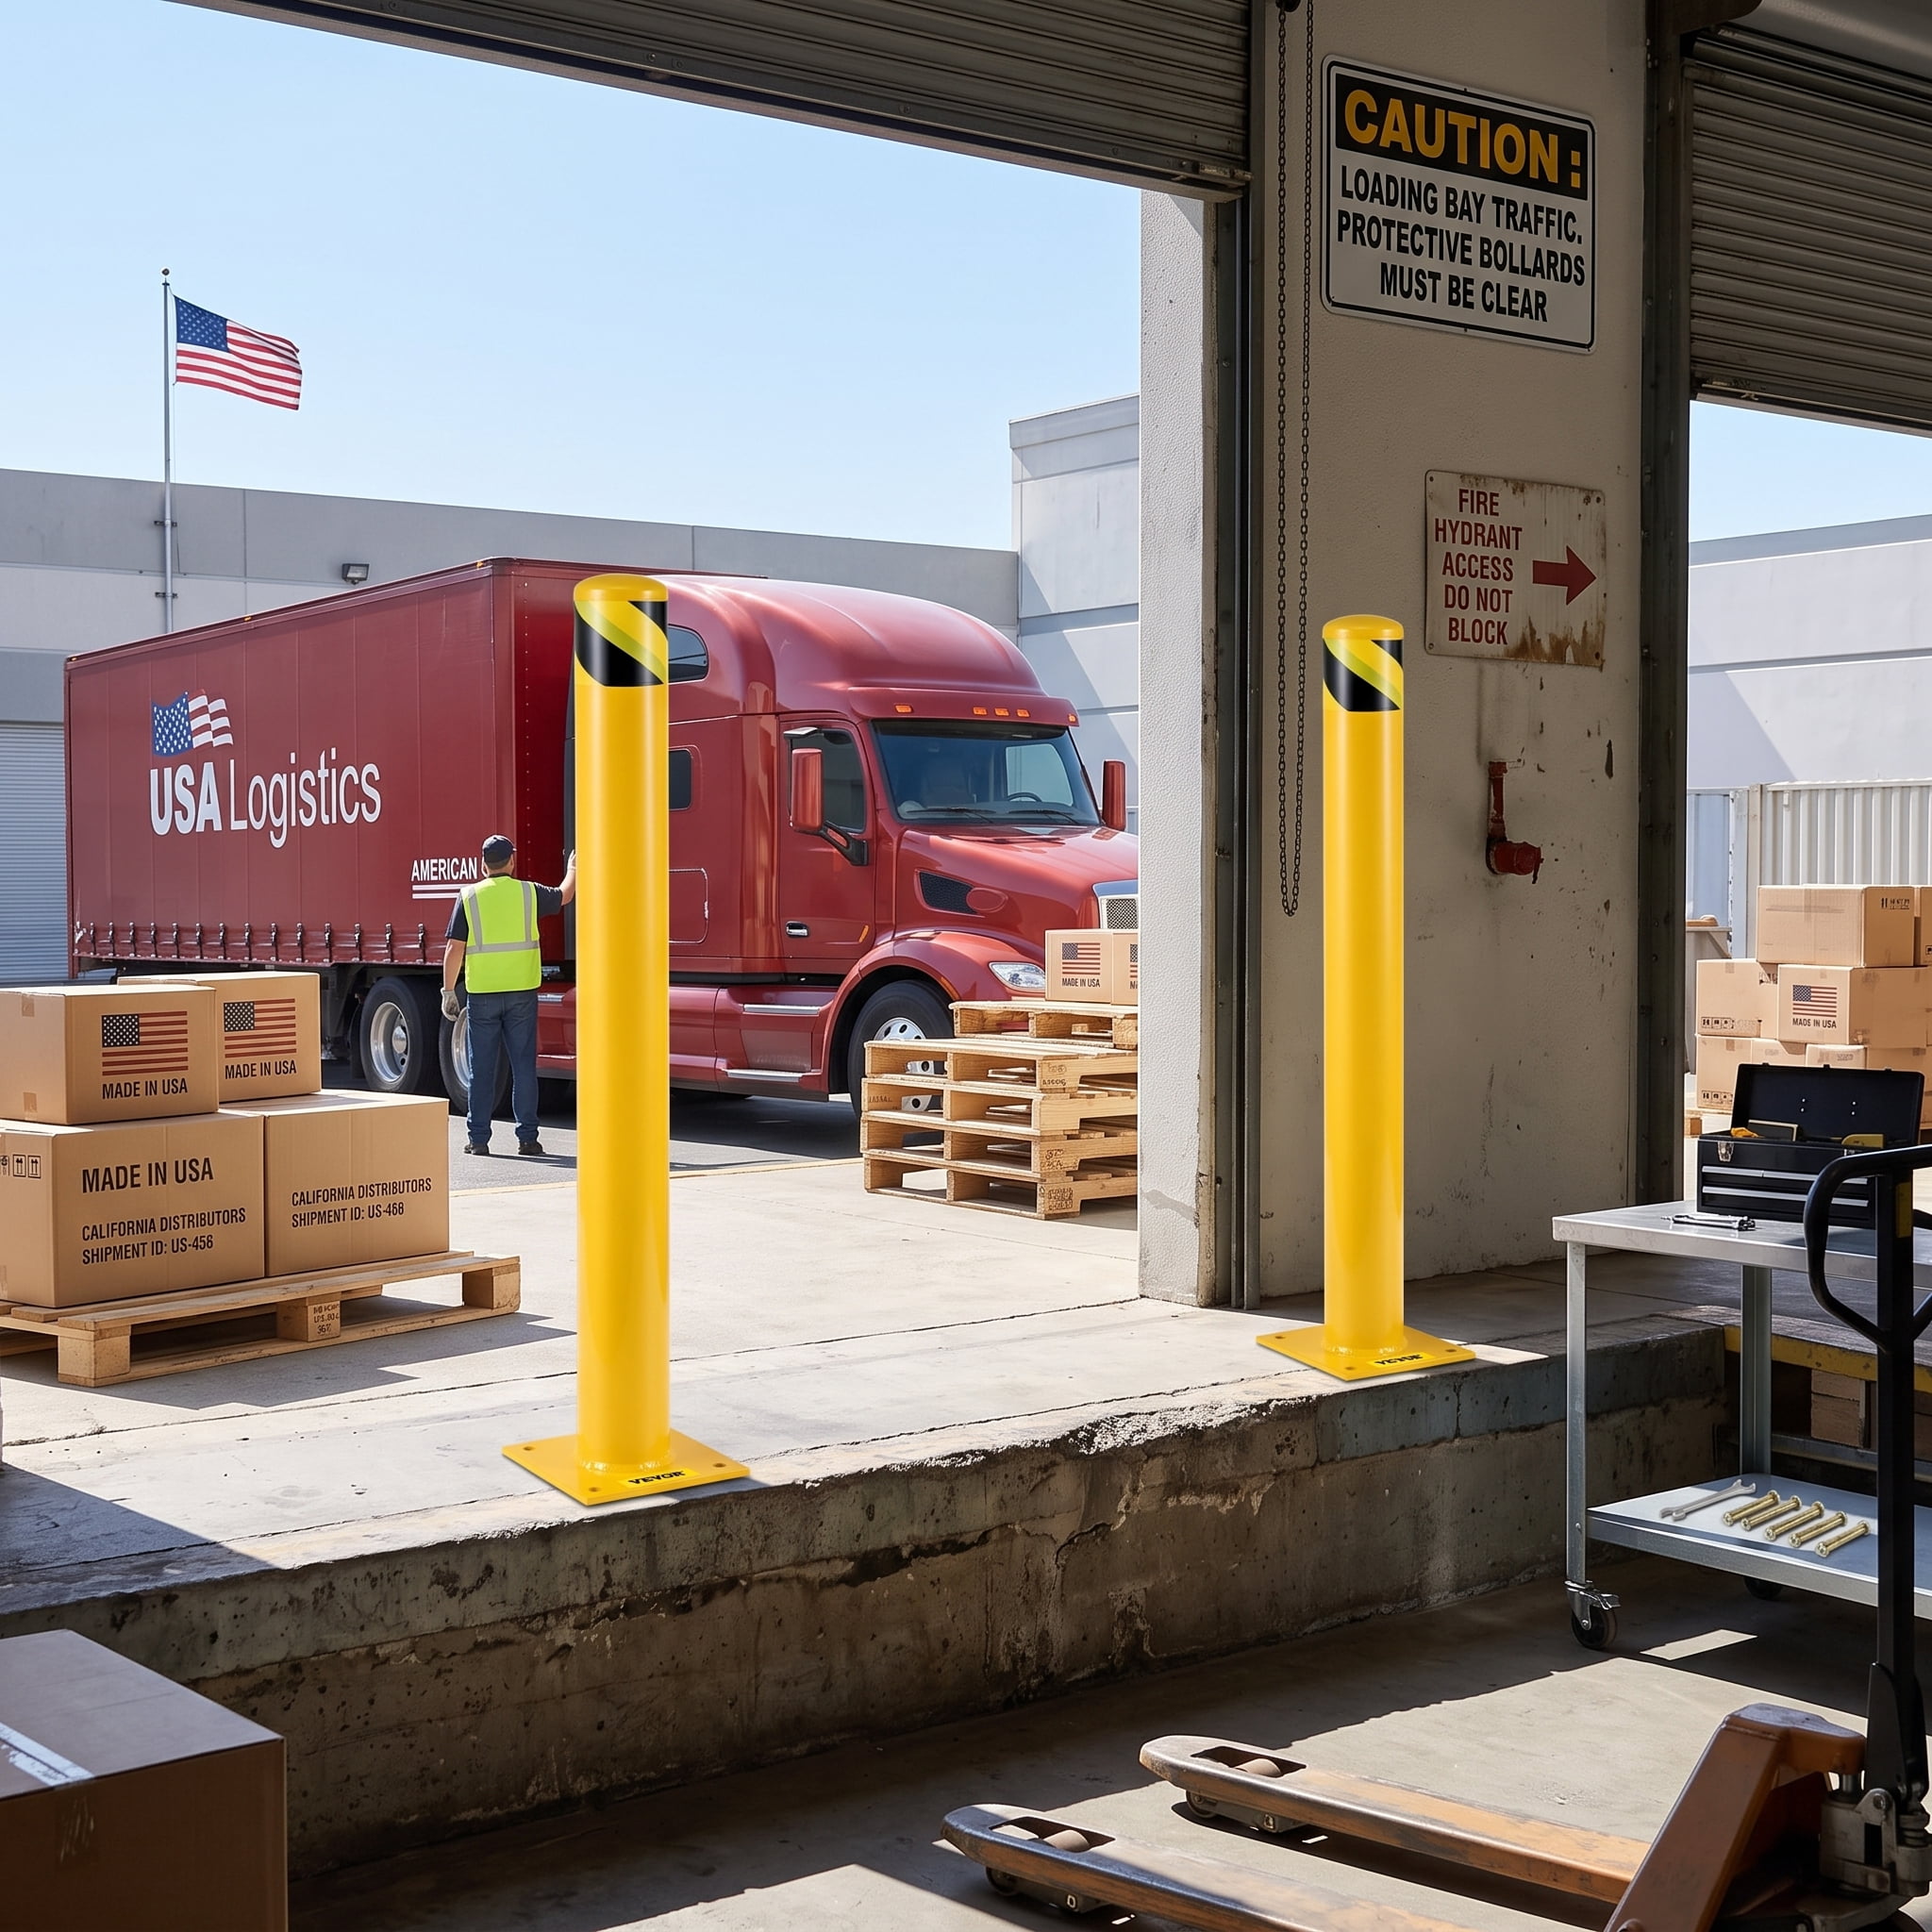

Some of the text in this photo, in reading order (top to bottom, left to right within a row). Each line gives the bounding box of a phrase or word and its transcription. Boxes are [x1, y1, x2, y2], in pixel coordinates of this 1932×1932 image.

[1341, 165, 1582, 244] LOADING BAY TRAFFIC.
[1338, 209, 1585, 287] PROTECTIVE BOLLARDS
[1380, 261, 1547, 322] MUST BE CLEAR
[1458, 488, 1499, 516] FIRE
[1435, 518, 1523, 550] HYDRANT
[1441, 551, 1513, 582] ACCESS
[1444, 584, 1513, 613] DO NOT
[1448, 617, 1508, 645] BLOCK
[150, 747, 381, 848] USA Logistics
[410, 857, 477, 882] AMERICAN
[1079, 978, 1086, 987] IN
[1087, 978, 1101, 988] USA
[1813, 1019, 1821, 1027] IN
[1822, 1020, 1837, 1028] USA
[225, 1059, 297, 1080] MADE IN USA
[102, 1077, 188, 1100] MADE IN USA
[82, 1157, 214, 1194] MADE IN USA
[291, 1177, 432, 1207] CALIFORNIA DISTRIBUTORS
[82, 1207, 246, 1241] CALIFORNIA DISTRIBUTORS
[291, 1208, 348, 1228] SHIPMENT
[350, 1206, 365, 1221] ID:
[82, 1241, 148, 1265] SHIPMENT
[151, 1241, 167, 1257] ID:
[627, 1470, 686, 1485] VEVOR
